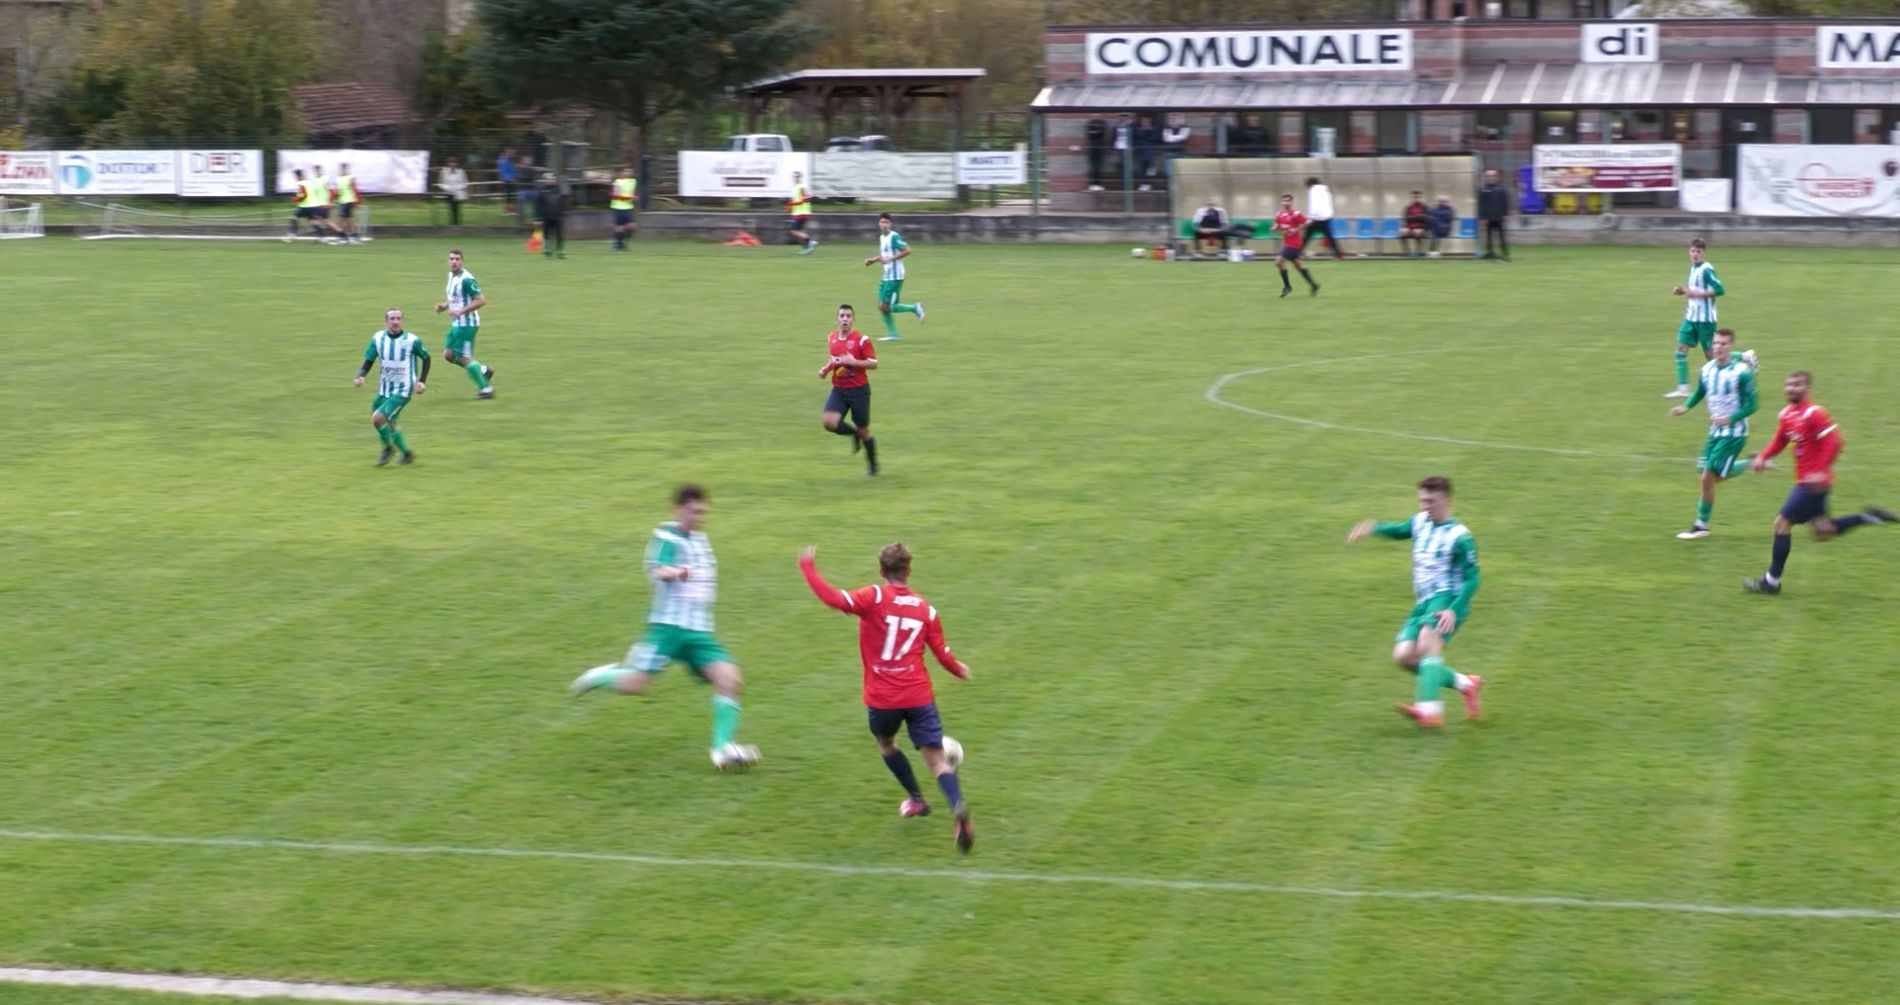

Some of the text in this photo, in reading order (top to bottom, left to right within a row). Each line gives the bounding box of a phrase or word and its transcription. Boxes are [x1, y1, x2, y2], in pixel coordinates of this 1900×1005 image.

[1098, 33, 1401, 68] COMUNALE
[1597, 27, 1646, 56] di
[881, 615, 924, 661] 17
